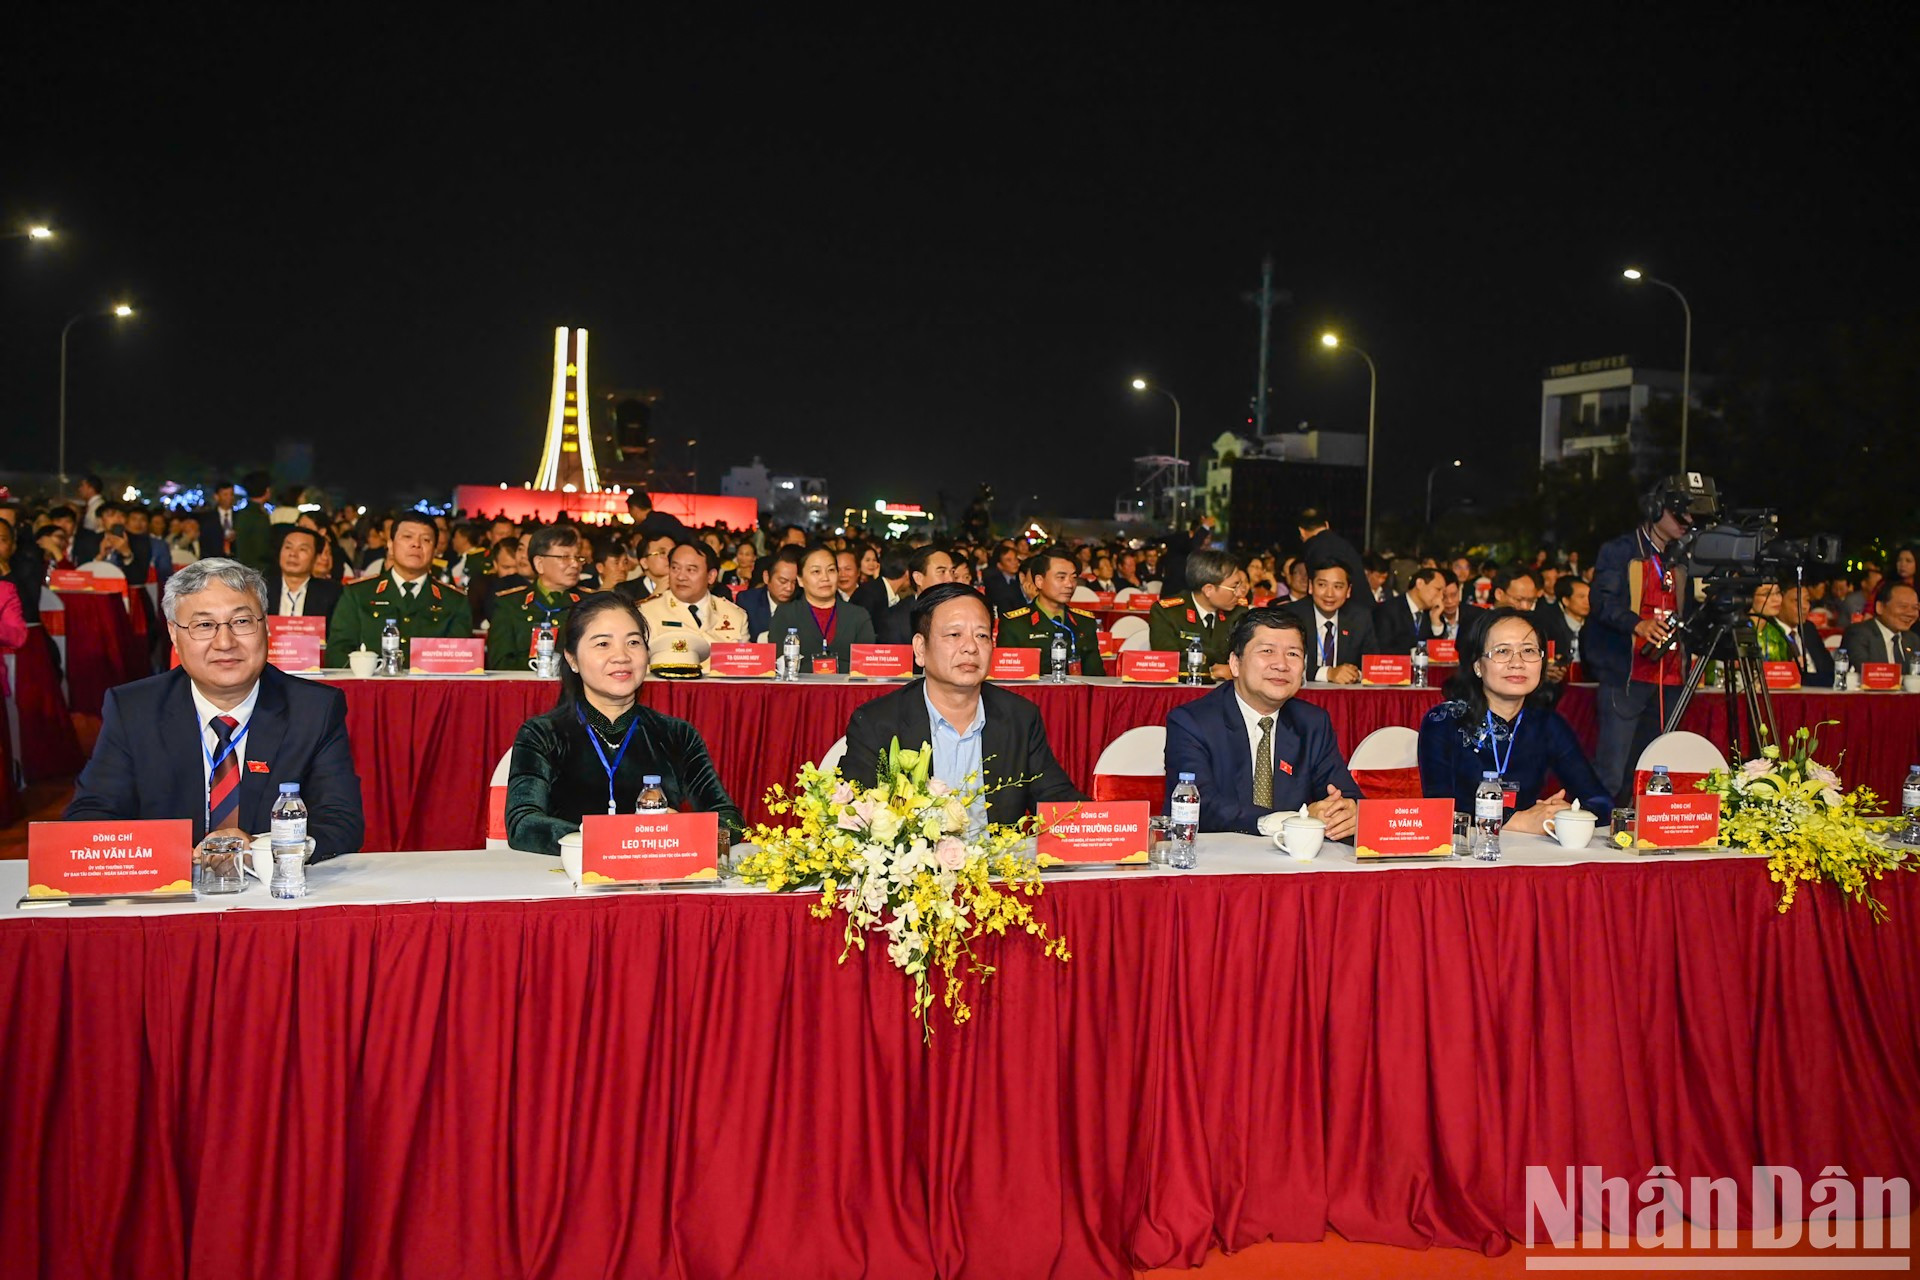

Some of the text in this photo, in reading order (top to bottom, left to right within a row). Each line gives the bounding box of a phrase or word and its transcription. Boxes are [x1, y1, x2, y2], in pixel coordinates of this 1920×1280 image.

[1694, 475, 1699, 484] 4
[1647, 812, 1669, 822] NGUYỄN
[1671, 814, 1680, 823] THỊ
[635, 824, 668, 833] ĐỒNG CHÍ
[1049, 823, 1138, 834] NGUYỄN TRƯỜNG GIANG
[1388, 818, 1423, 829] TẠ VĂN HẠ
[92, 833, 132, 842] ĐỒNG CHÍ
[622, 839, 679, 850] LEO THỊ LỊCH
[70, 846, 153, 860] TRẦN VĂN LÂM
